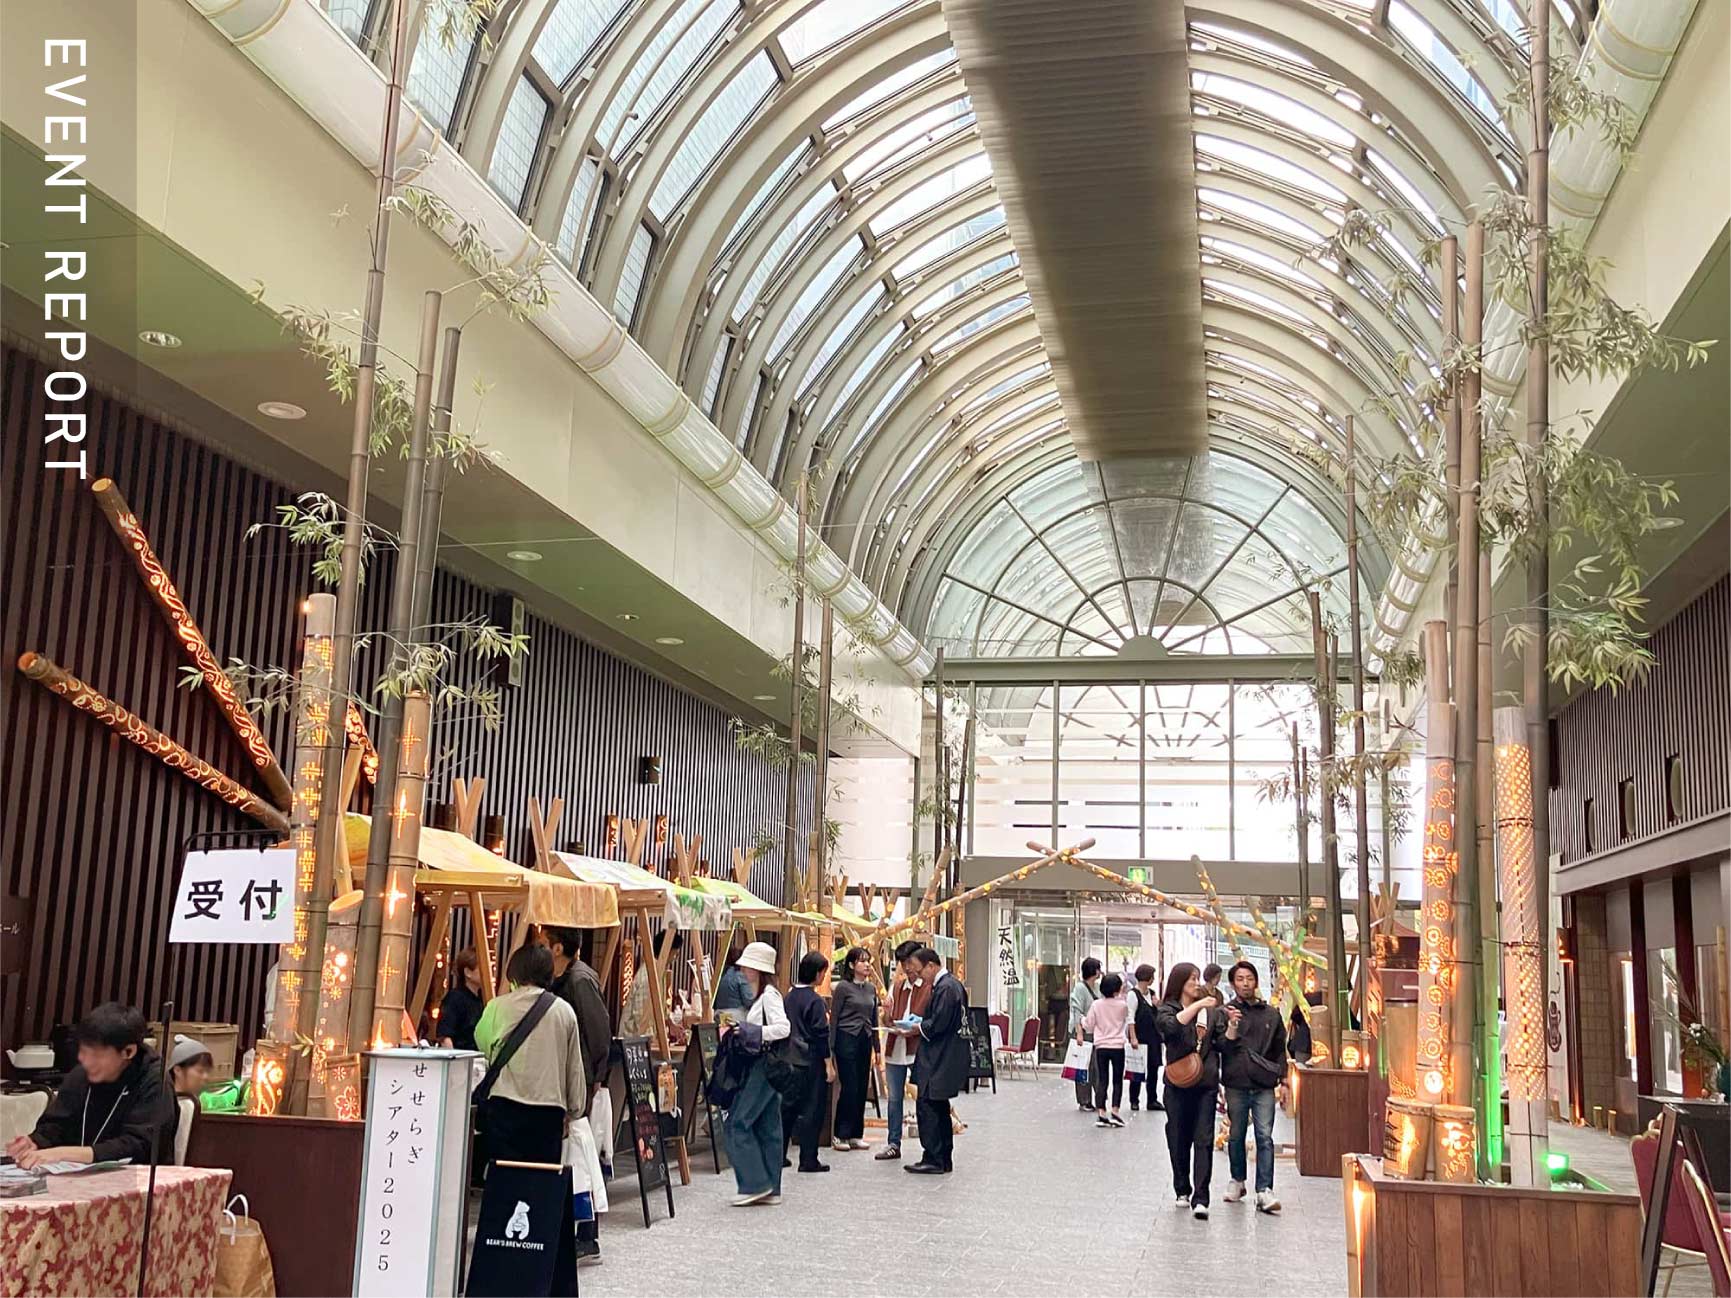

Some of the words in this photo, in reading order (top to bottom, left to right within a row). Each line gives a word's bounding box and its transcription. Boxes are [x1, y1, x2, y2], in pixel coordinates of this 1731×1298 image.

[184, 879, 283, 921] 受付
[407, 1062, 428, 1164] せせらぎ
[377, 1079, 404, 1271] シアター2025
[505, 1240, 521, 1248] BREW
[522, 1241, 544, 1251] COFFEE
